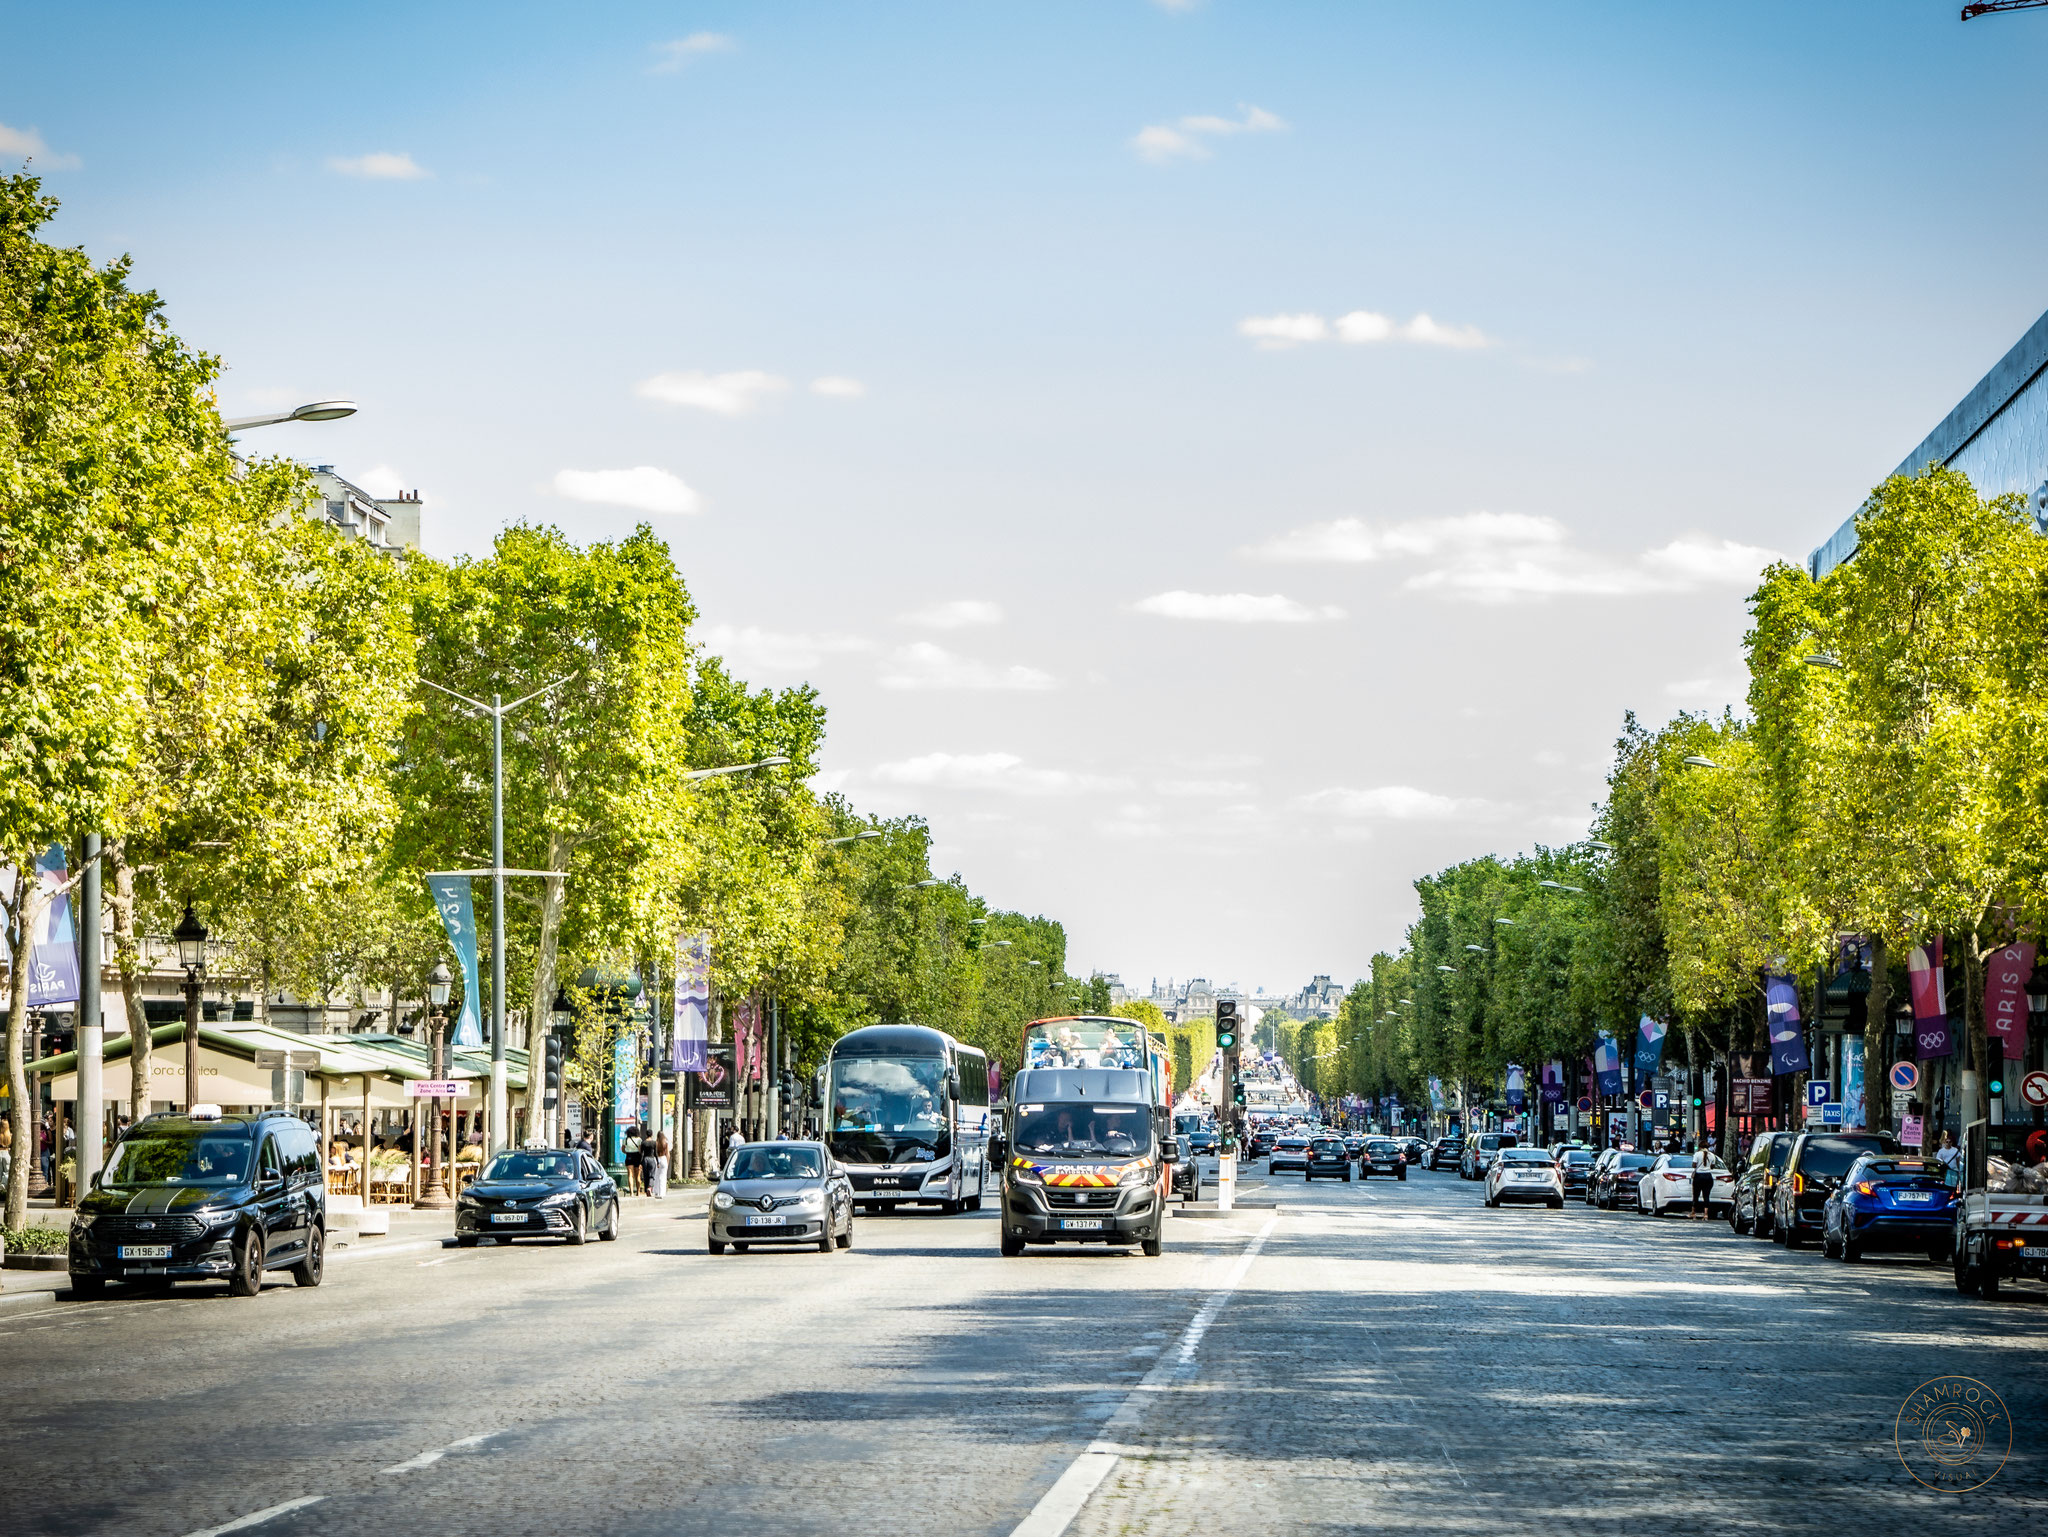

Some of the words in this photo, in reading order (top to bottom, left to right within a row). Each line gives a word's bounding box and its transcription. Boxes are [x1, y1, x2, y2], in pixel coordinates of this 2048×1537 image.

[151, 1066, 174, 1076] ora
[1815, 1086, 1827, 1102] P
[1656, 1094, 1667, 1108] P
[1558, 1104, 1565, 1113] P
